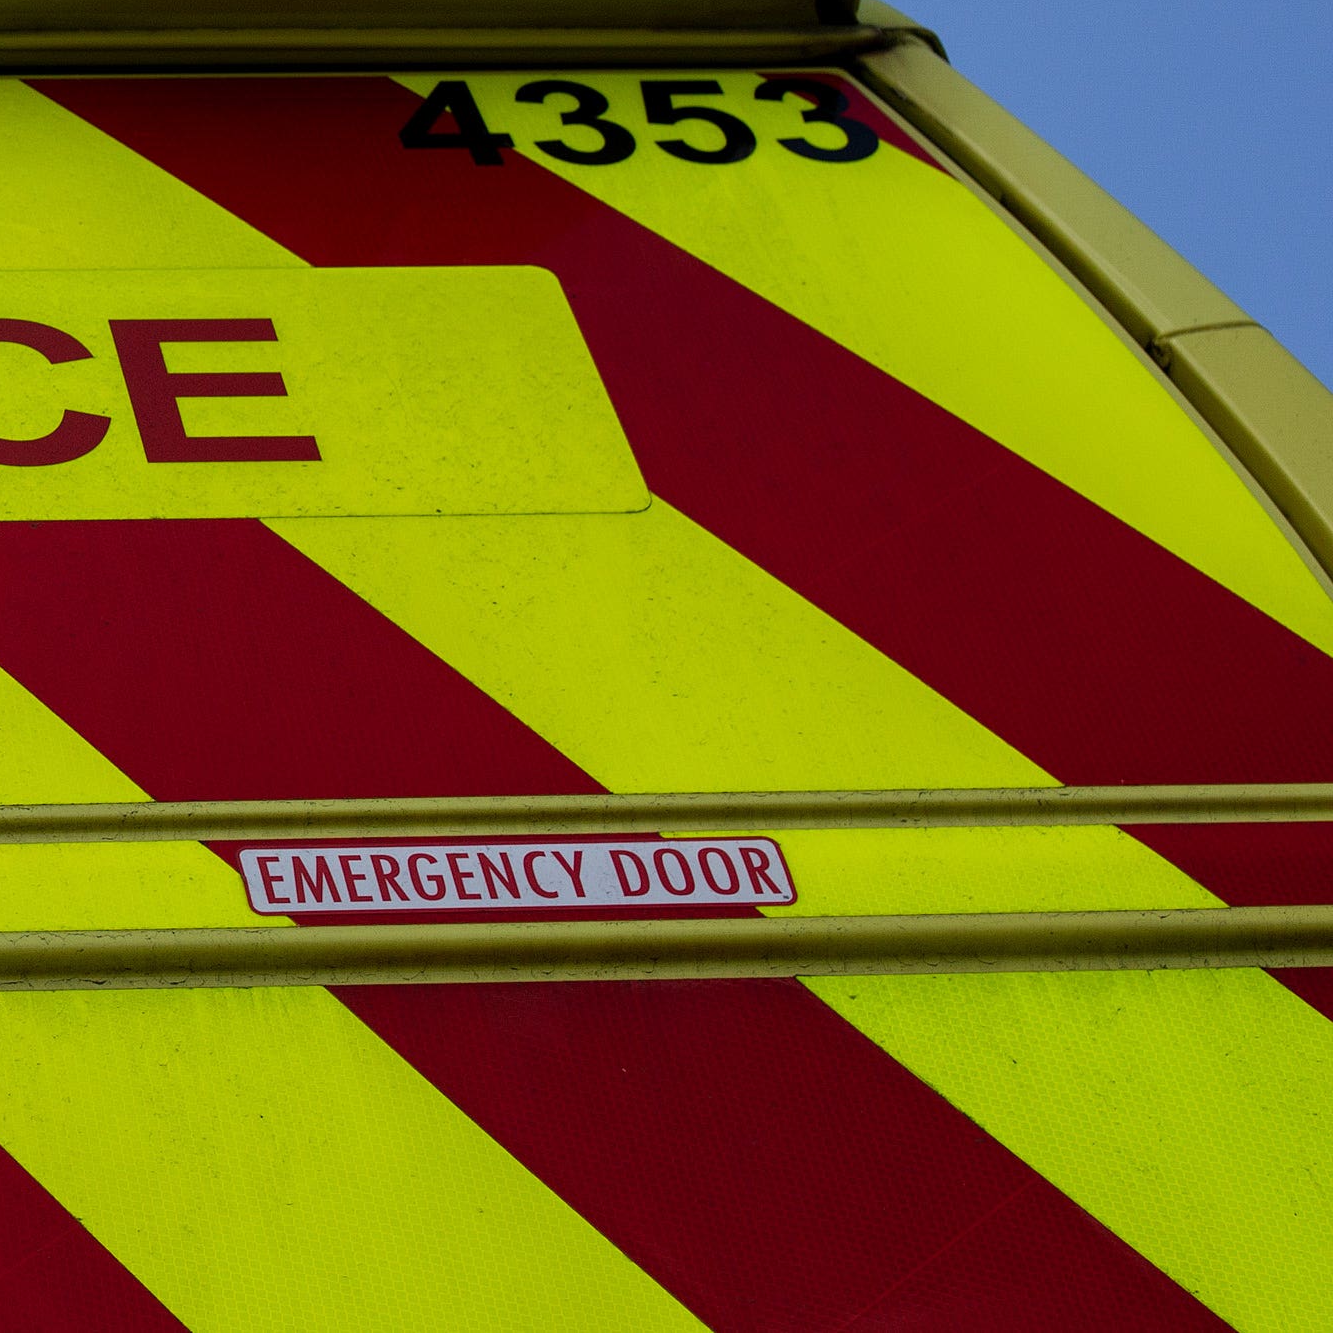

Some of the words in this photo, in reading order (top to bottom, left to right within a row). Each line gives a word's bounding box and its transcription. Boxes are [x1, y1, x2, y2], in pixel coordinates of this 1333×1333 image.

[398, 79, 879, 166] 4353
[256, 850, 585, 904] EMERGENCY
[609, 846, 783, 897] DOOR
